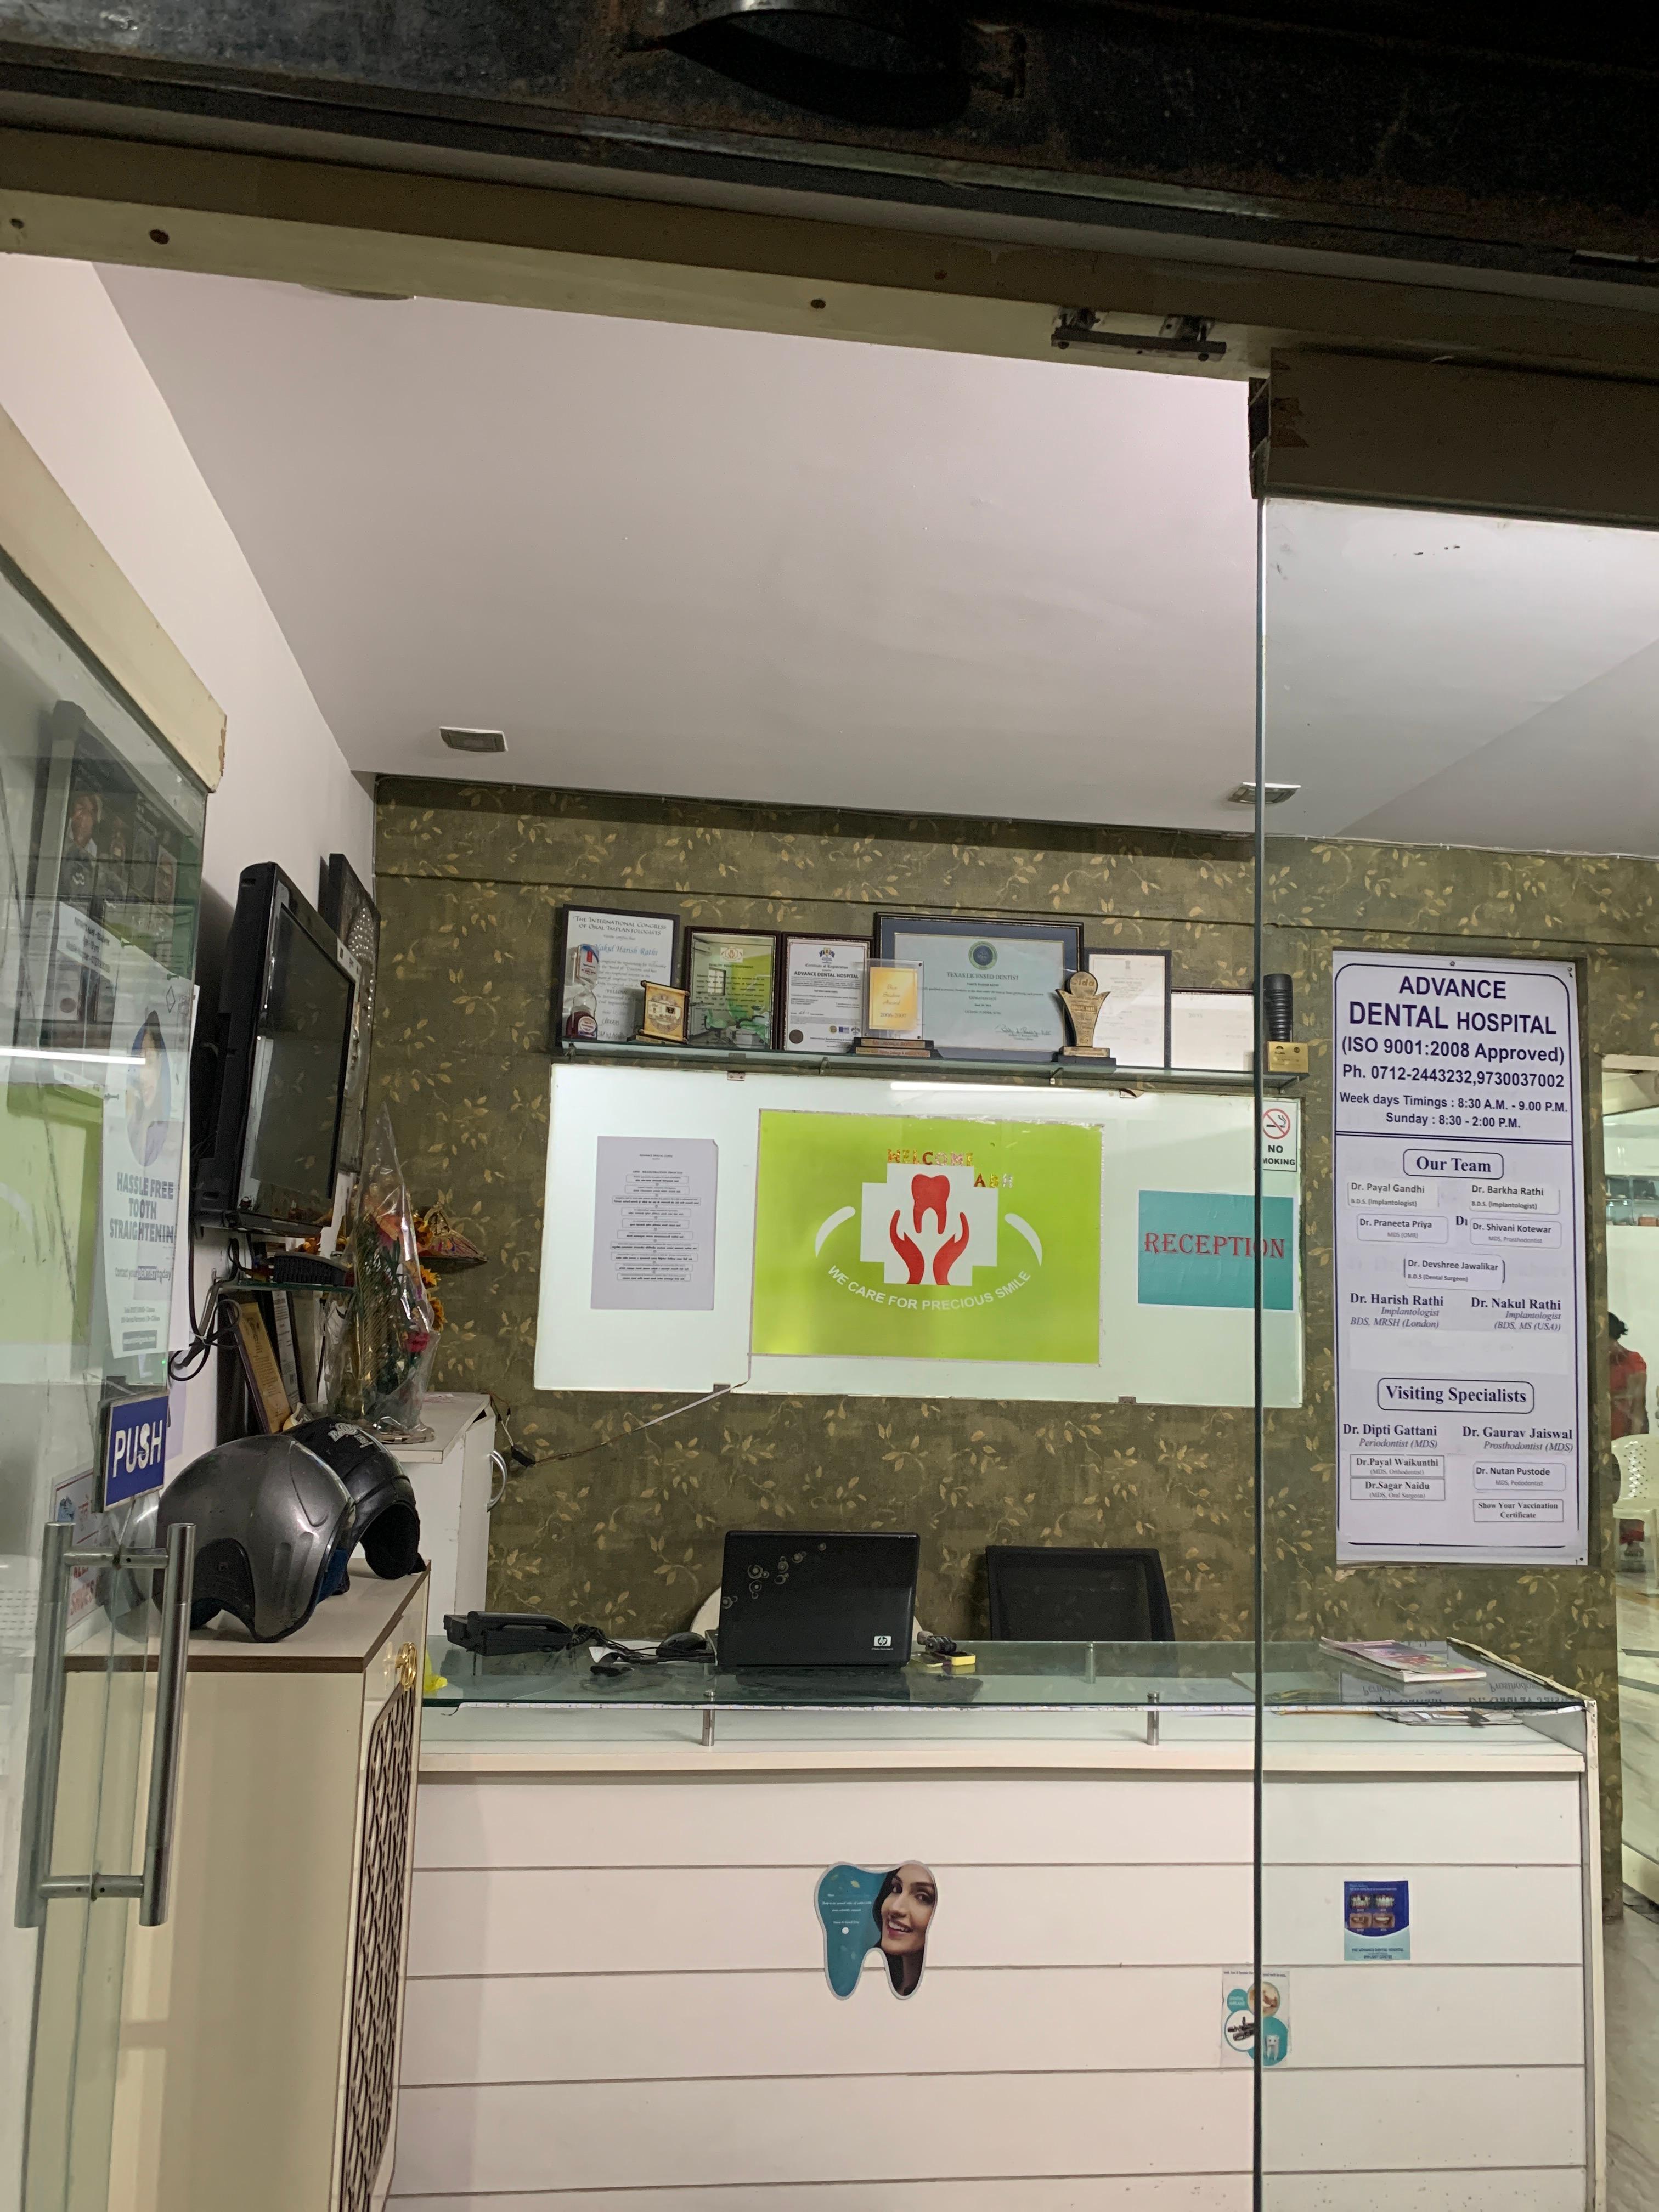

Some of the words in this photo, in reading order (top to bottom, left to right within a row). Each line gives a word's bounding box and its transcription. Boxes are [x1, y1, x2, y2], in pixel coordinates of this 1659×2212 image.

[1398, 975, 1506, 1000] ADVANCE
[1349, 1001, 1448, 1029] DENTAL
[1457, 1011, 1557, 1035] HOSPITAL
[1342, 1036, 1378, 1054] (ISO
[1384, 1039, 1470, 1058] 9001:2008
[1475, 1043, 1565, 1066] Approved)
[1342, 1064, 1366, 1079] Ph.
[1371, 1066, 1565, 1088] 0712-2443232,9730037002
[1339, 1092, 1370, 1103] Week
[1373, 1094, 1400, 1106] days
[1403, 1095, 1447, 1109] Timings
[1458, 1098, 1481, 1109] 8:30
[1483, 1099, 1509, 1110] A.M.
[1519, 1101, 1542, 1112] 9.00
[1545, 1102, 1568, 1113] P.M.
[1386, 1112, 1429, 1126] Sunday
[1439, 1115, 1462, 1126] 8:30
[1472, 1116, 1495, 1127] 2:00
[1498, 1117, 1521, 1129] P.M.
[887, 1148, 974, 1167] WELCOME
[1415, 1156, 1447, 1171] Our
[1451, 1158, 1492, 1173] Team
[117, 1171, 149, 1196] HASSLE
[150, 1179, 174, 1200] FREE
[1351, 1182, 1364, 1190] Dr.
[1367, 1183, 1391, 1193] Payal
[1393, 1184, 1425, 1194] Gandhi
[1471, 1184, 1485, 1193] Dr.
[1487, 1186, 1518, 1195] Barkha
[1521, 1187, 1544, 1197] Rathi
[128, 1198, 157, 1220] TOOTH
[1368, 1198, 1417, 1208] (Implantologist)
[1488, 1200, 1538, 1210] (Implantologist)
[110, 1218, 176, 1243] STRAIGHTENIN
[1359, 1218, 1372, 1226] Dr.
[1374, 1218, 1410, 1228] Praneeta
[1412, 1220, 1432, 1230] Priya
[1472, 1223, 1485, 1231] Dr.
[1487, 1223, 1515, 1232] Shivani
[1517, 1224, 1551, 1233] Kotewar
[1408, 1259, 1420, 1267] Dr.
[1422, 1260, 1459, 1269] Devshree
[1461, 1261, 1498, 1271] Jawalikar
[827, 1264, 847, 1288] WE
[847, 1280, 885, 1305] CARE
[888, 1294, 919, 1311] FOR
[921, 1291, 994, 1311] PRECIOUS
[995, 1268, 1031, 1300] SMILE
[1350, 1293, 1367, 1304] Dr.
[1370, 1294, 1409, 1306] Harish
[1413, 1295, 1444, 1307] Rathi
[1471, 1297, 1488, 1307] Dr.
[1492, 1297, 1526, 1309] Nakul
[1529, 1299, 1561, 1311] Rathi
[1381, 1307, 1440, 1317] Implantologist
[1505, 1311, 1561, 1321] Implantologist
[1350, 1317, 1370, 1327] BDS,
[1373, 1317, 1400, 1327] MRSH
[1402, 1318, 1440, 1329] (London)
[1519, 1321, 1532, 1330] MS
[1386, 1385, 1444, 1404] Visiting
[1448, 1387, 1526, 1404] Specialists
[1342, 1424, 1359, 1435] Dr.
[1363, 1424, 1390, 1438] Dipti
[1394, 1425, 1437, 1437] Gattani
[1462, 1426, 1480, 1437] Dr.
[1483, 1427, 1525, 1438] Gaurav
[1529, 1427, 1572, 1440] Jaiswal
[112, 1419, 163, 1479] PUSH
[1359, 1438, 1408, 1448] Periodontist
[1410, 1439, 1438, 1449] (MDS)
[1483, 1441, 1543, 1452] Prosthodontist
[1545, 1442, 1573, 1452] (MDS)
[1476, 1466, 1488, 1475] Dr.
[1490, 1467, 1515, 1475] Nutan
[1516, 1468, 1550, 1476] Pustode
[1405, 1481, 1430, 1491] Naidu
[1500, 1511, 1536, 1519] Certificate
